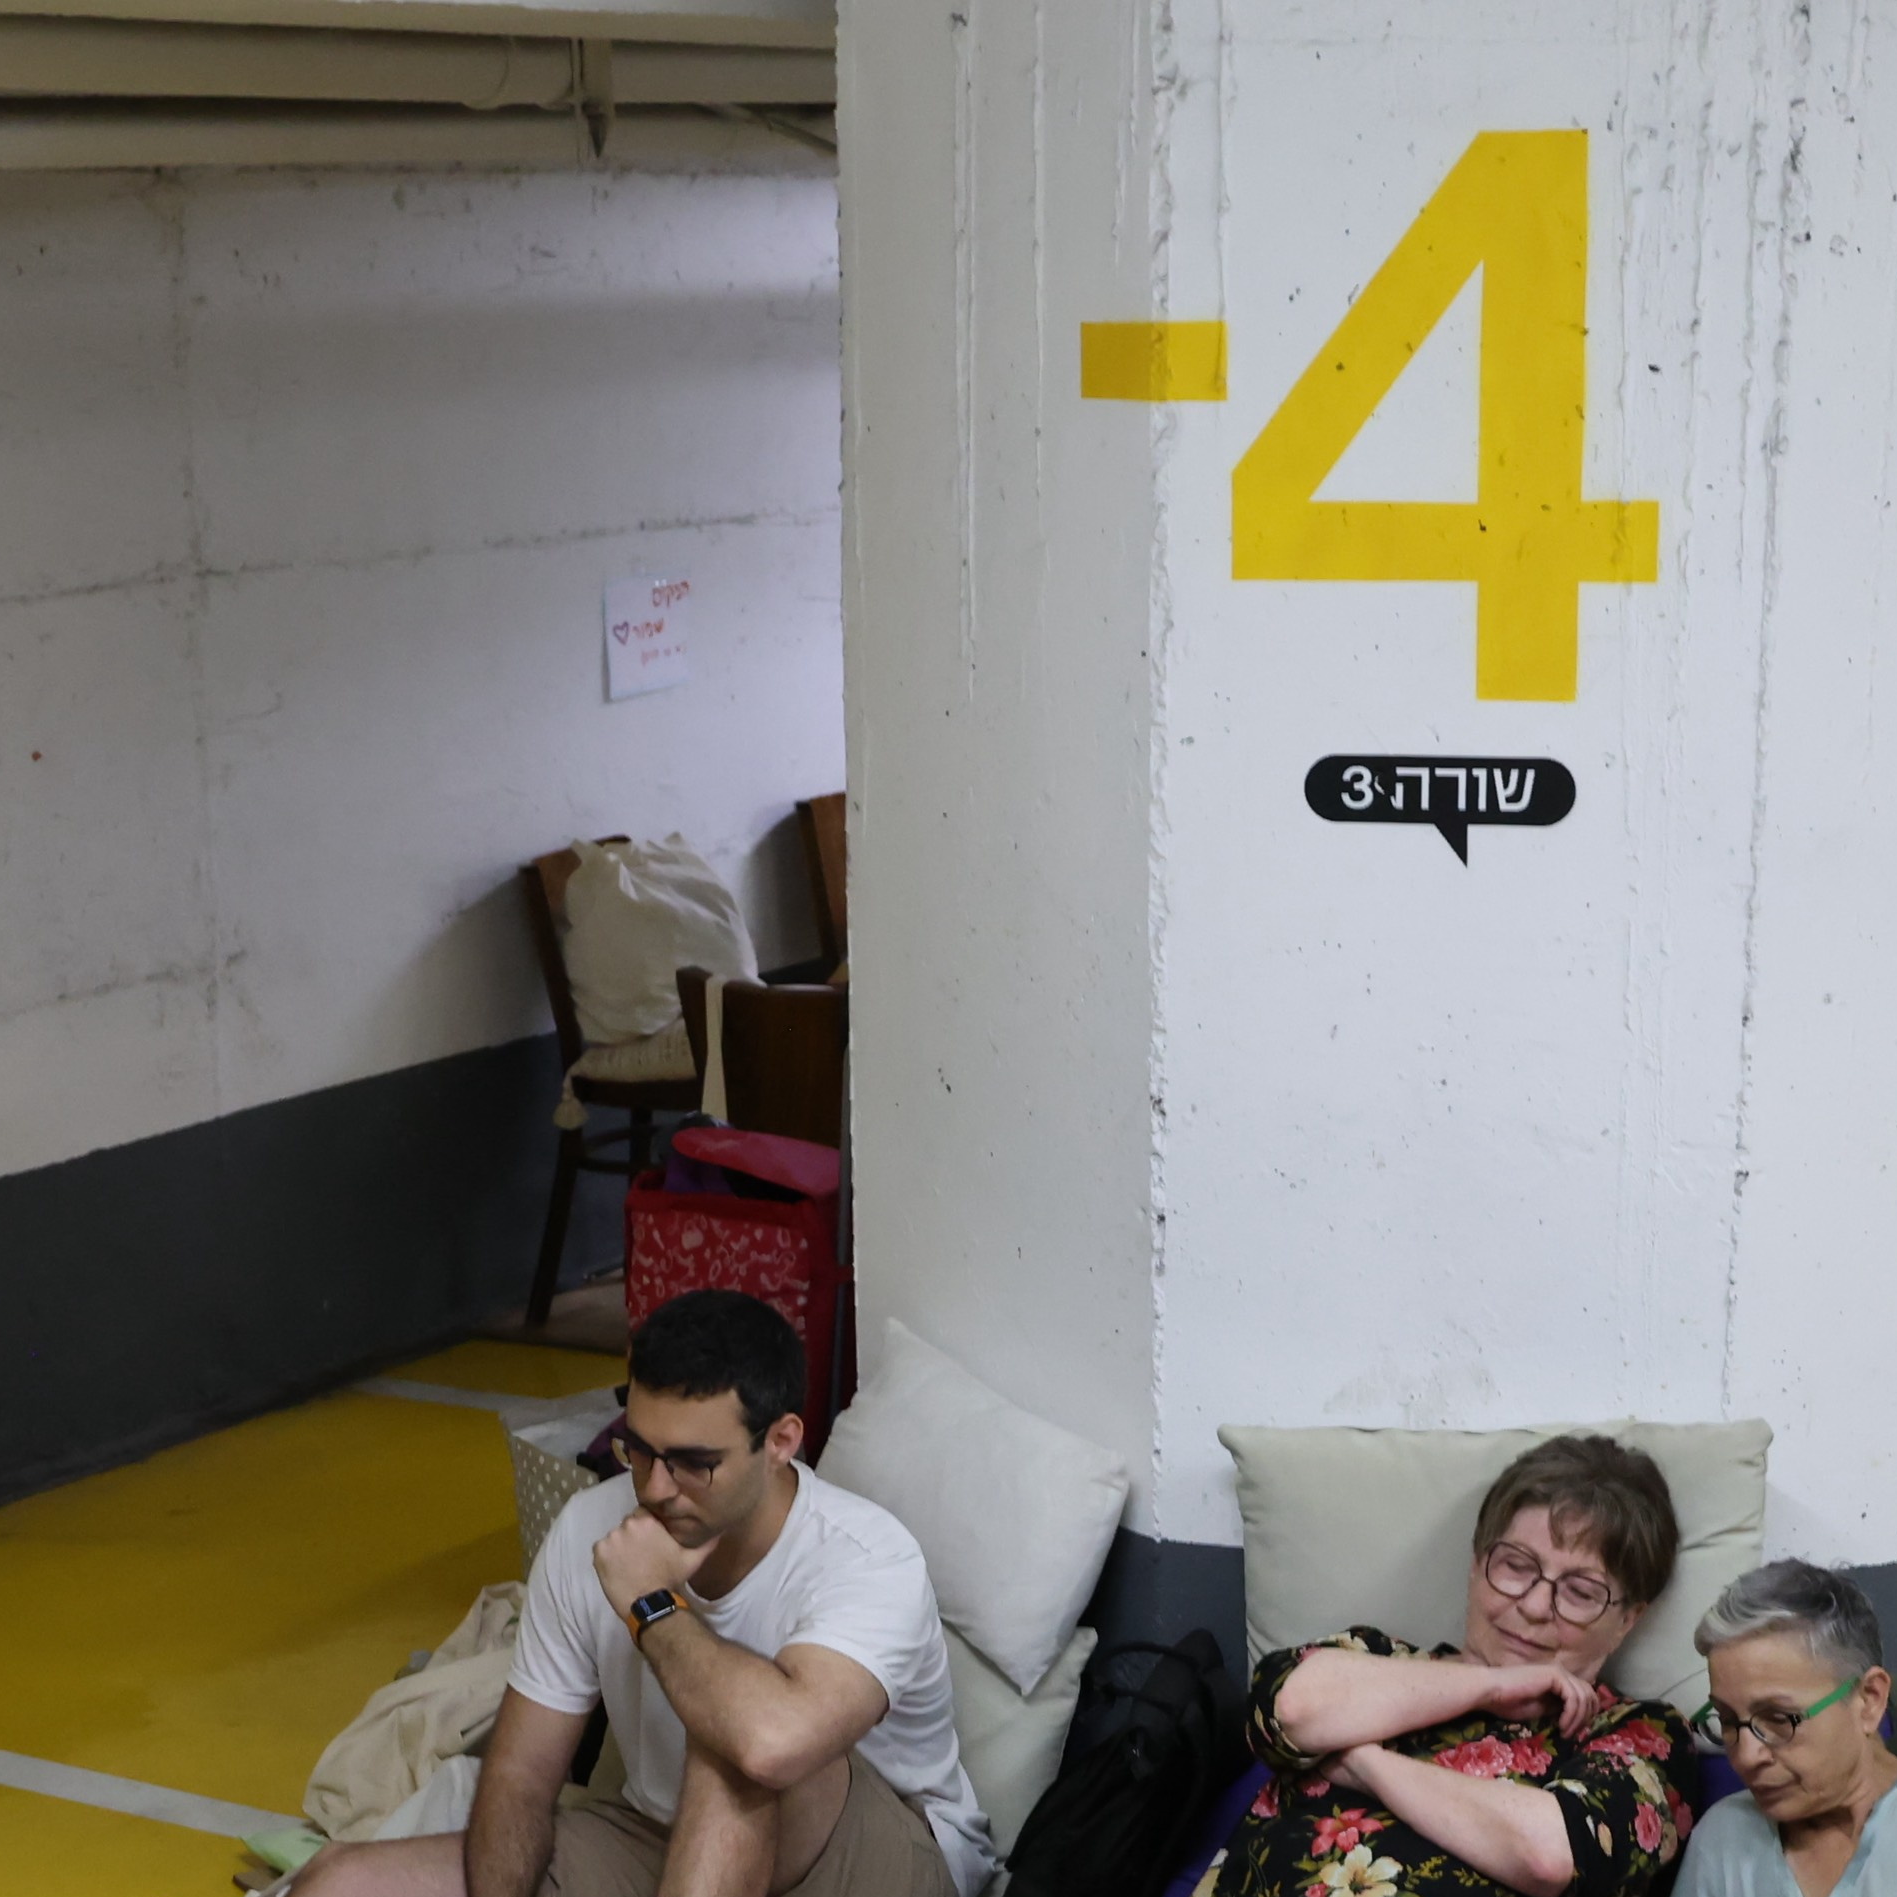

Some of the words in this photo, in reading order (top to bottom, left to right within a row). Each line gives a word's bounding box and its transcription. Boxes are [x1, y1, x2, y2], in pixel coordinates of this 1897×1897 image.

[1079, 128, 1660, 702] -4
[1340, 764, 1374, 811] 3
[1390, 766, 1536, 813] שורה
